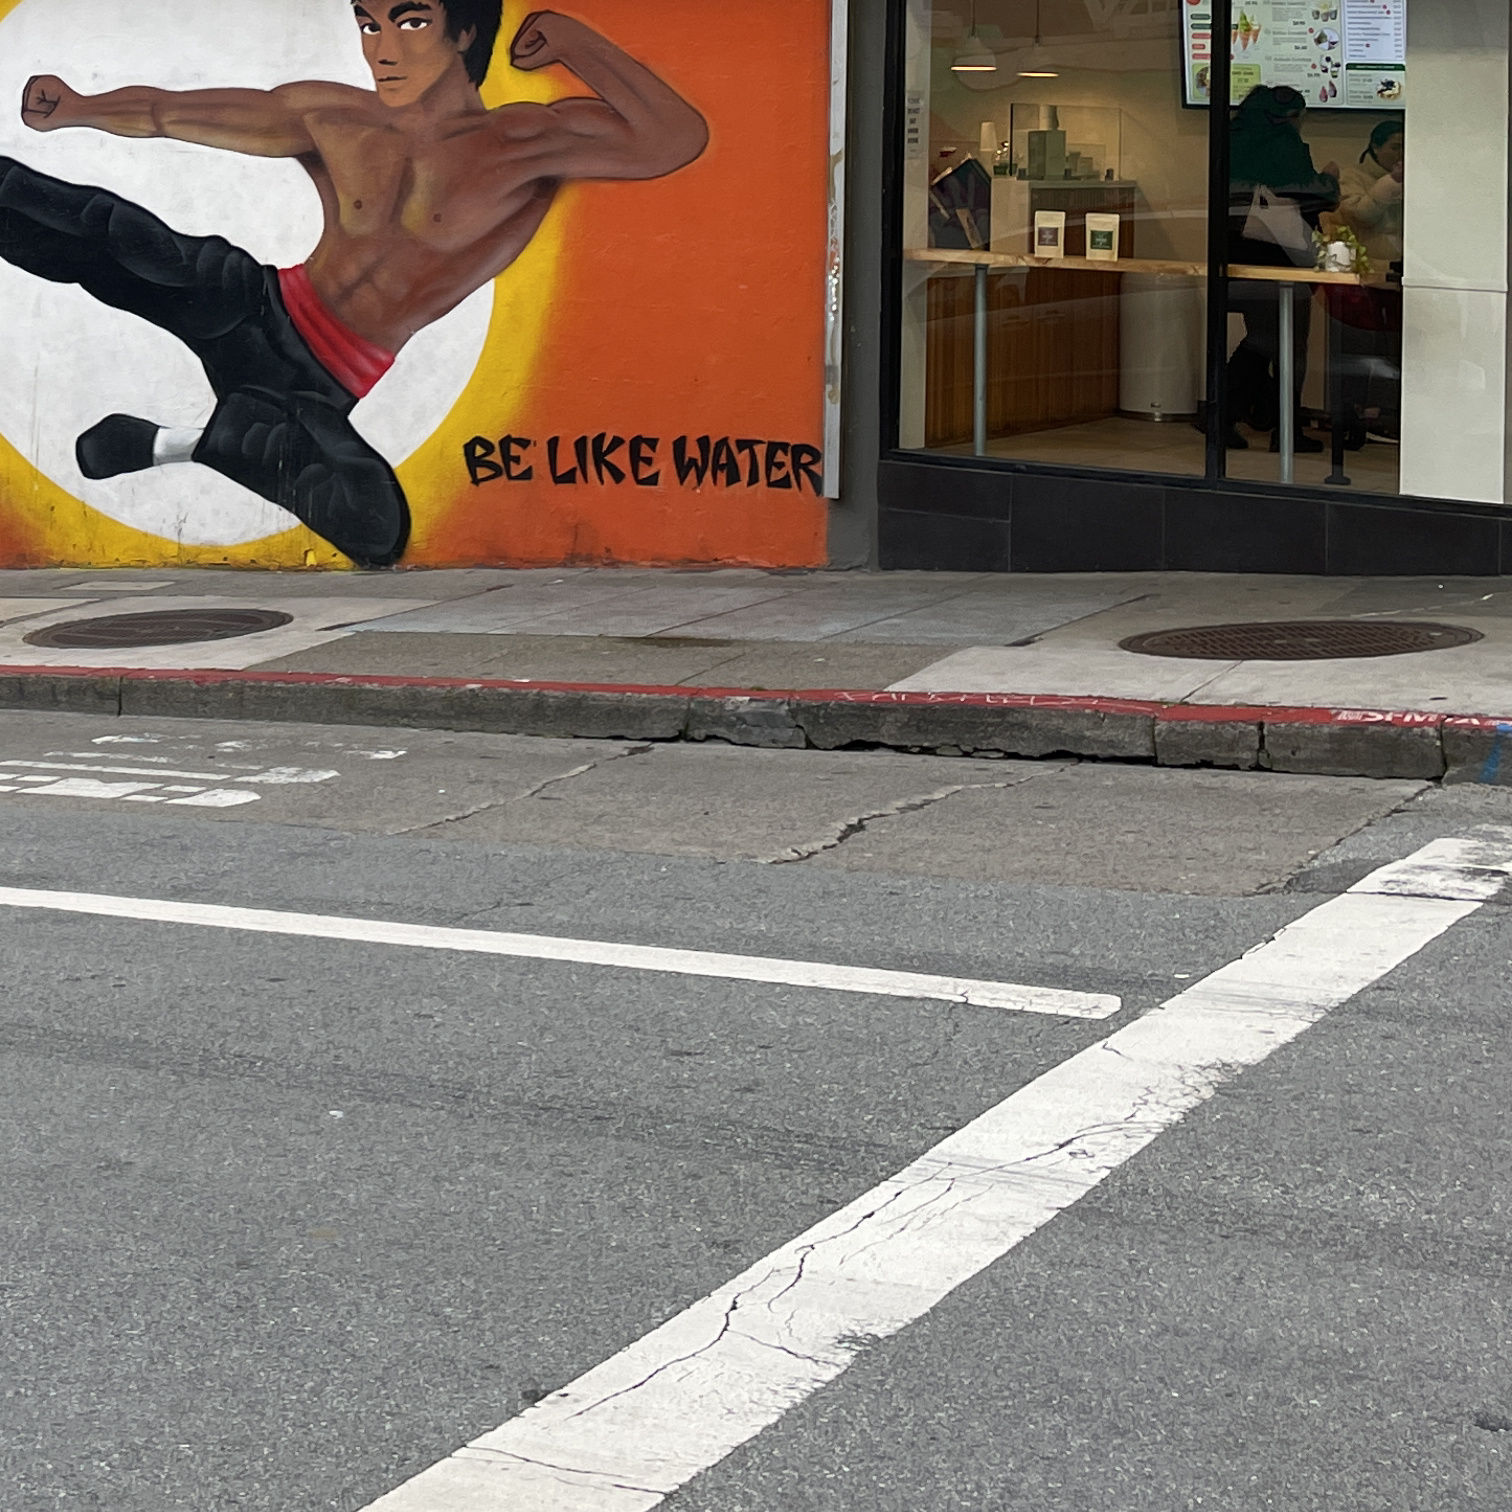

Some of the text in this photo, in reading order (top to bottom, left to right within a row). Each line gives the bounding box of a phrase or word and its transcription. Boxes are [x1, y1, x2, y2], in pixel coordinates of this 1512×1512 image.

[463, 431, 823, 497] BE LIKE WATER
